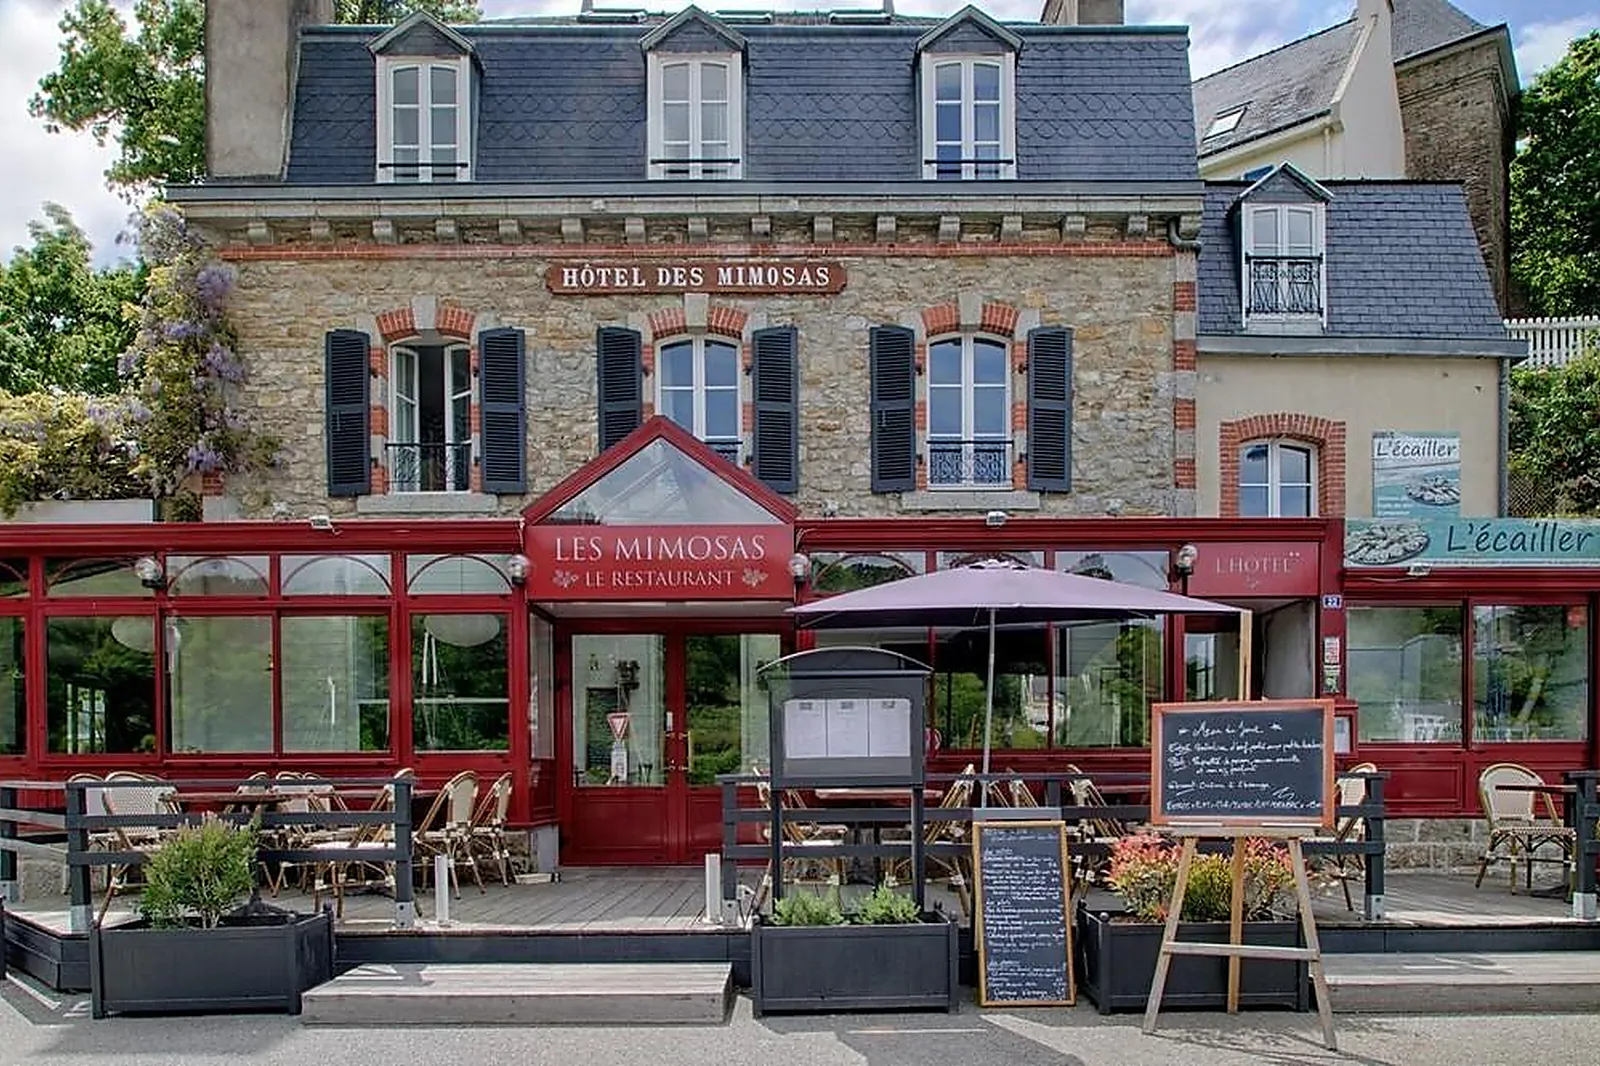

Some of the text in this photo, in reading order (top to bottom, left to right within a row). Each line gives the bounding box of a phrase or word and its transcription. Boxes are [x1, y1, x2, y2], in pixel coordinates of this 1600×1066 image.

[562, 264, 830, 287] HÔTEL DES MIMOSAS
[1377, 440, 1457, 457] L'écailler
[555, 534, 766, 561] LES MIMOSAS
[1447, 522, 1595, 552] L'écailler
[585, 569, 736, 588] LE RESTAURANT
